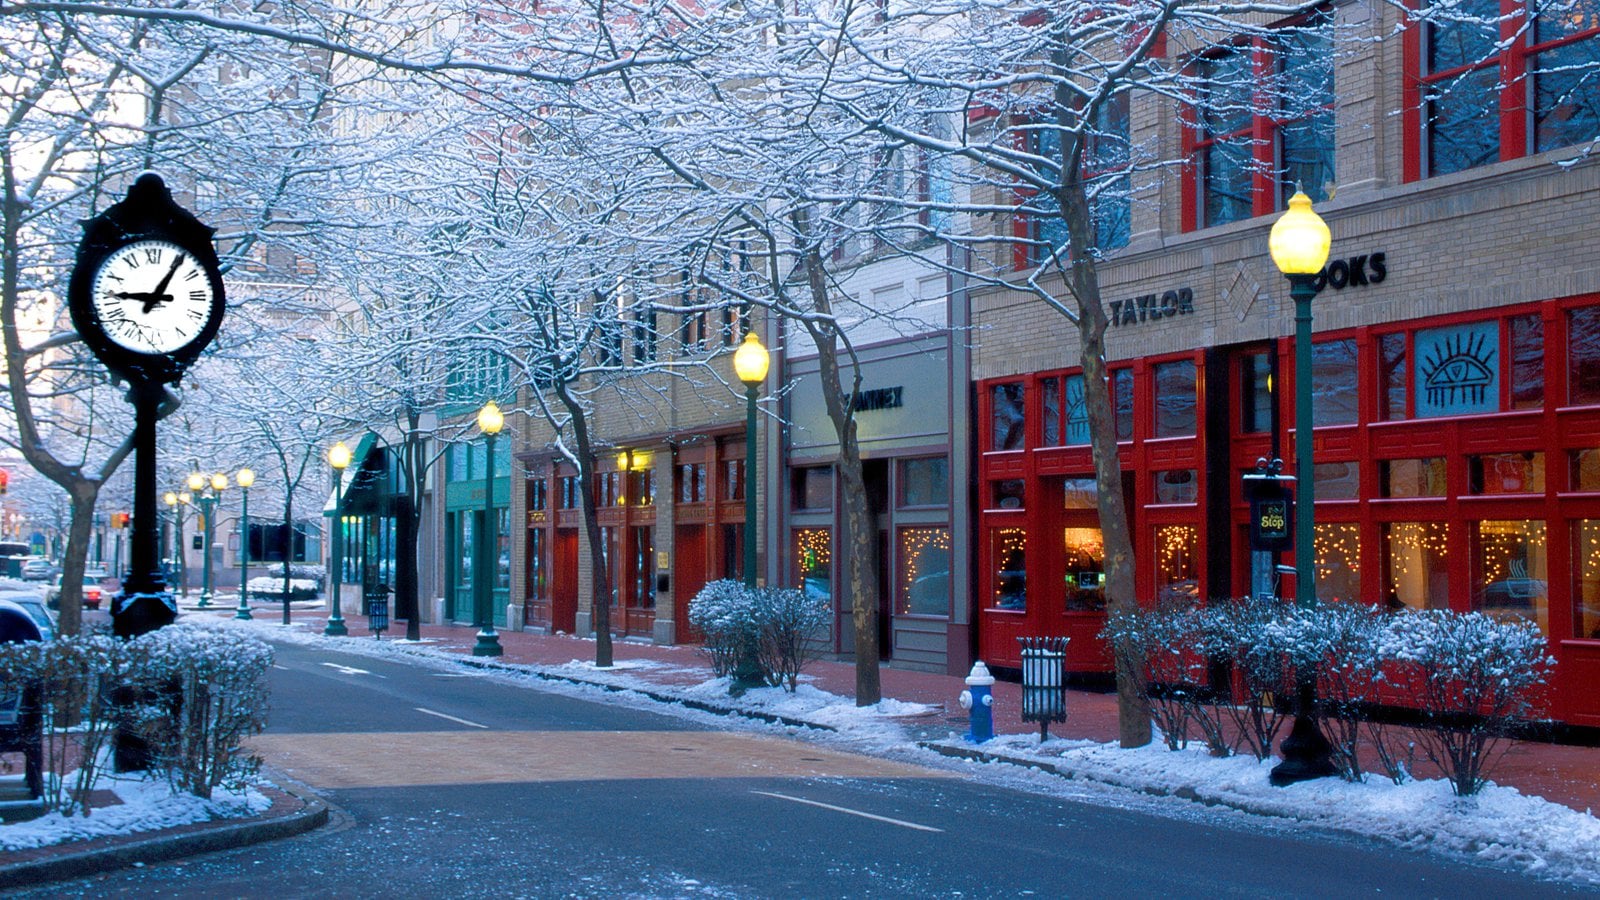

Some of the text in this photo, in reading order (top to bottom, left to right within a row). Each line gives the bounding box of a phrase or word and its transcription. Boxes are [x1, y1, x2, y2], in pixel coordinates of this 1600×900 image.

[121, 252, 140, 270] XI
[145, 248, 162, 265] XII
[106, 270, 125, 285] X
[183, 269, 199, 281] II
[189, 290, 207, 301] III
[1109, 287, 1194, 328] TAYLOR
[1261, 515, 1284, 529] Stop
